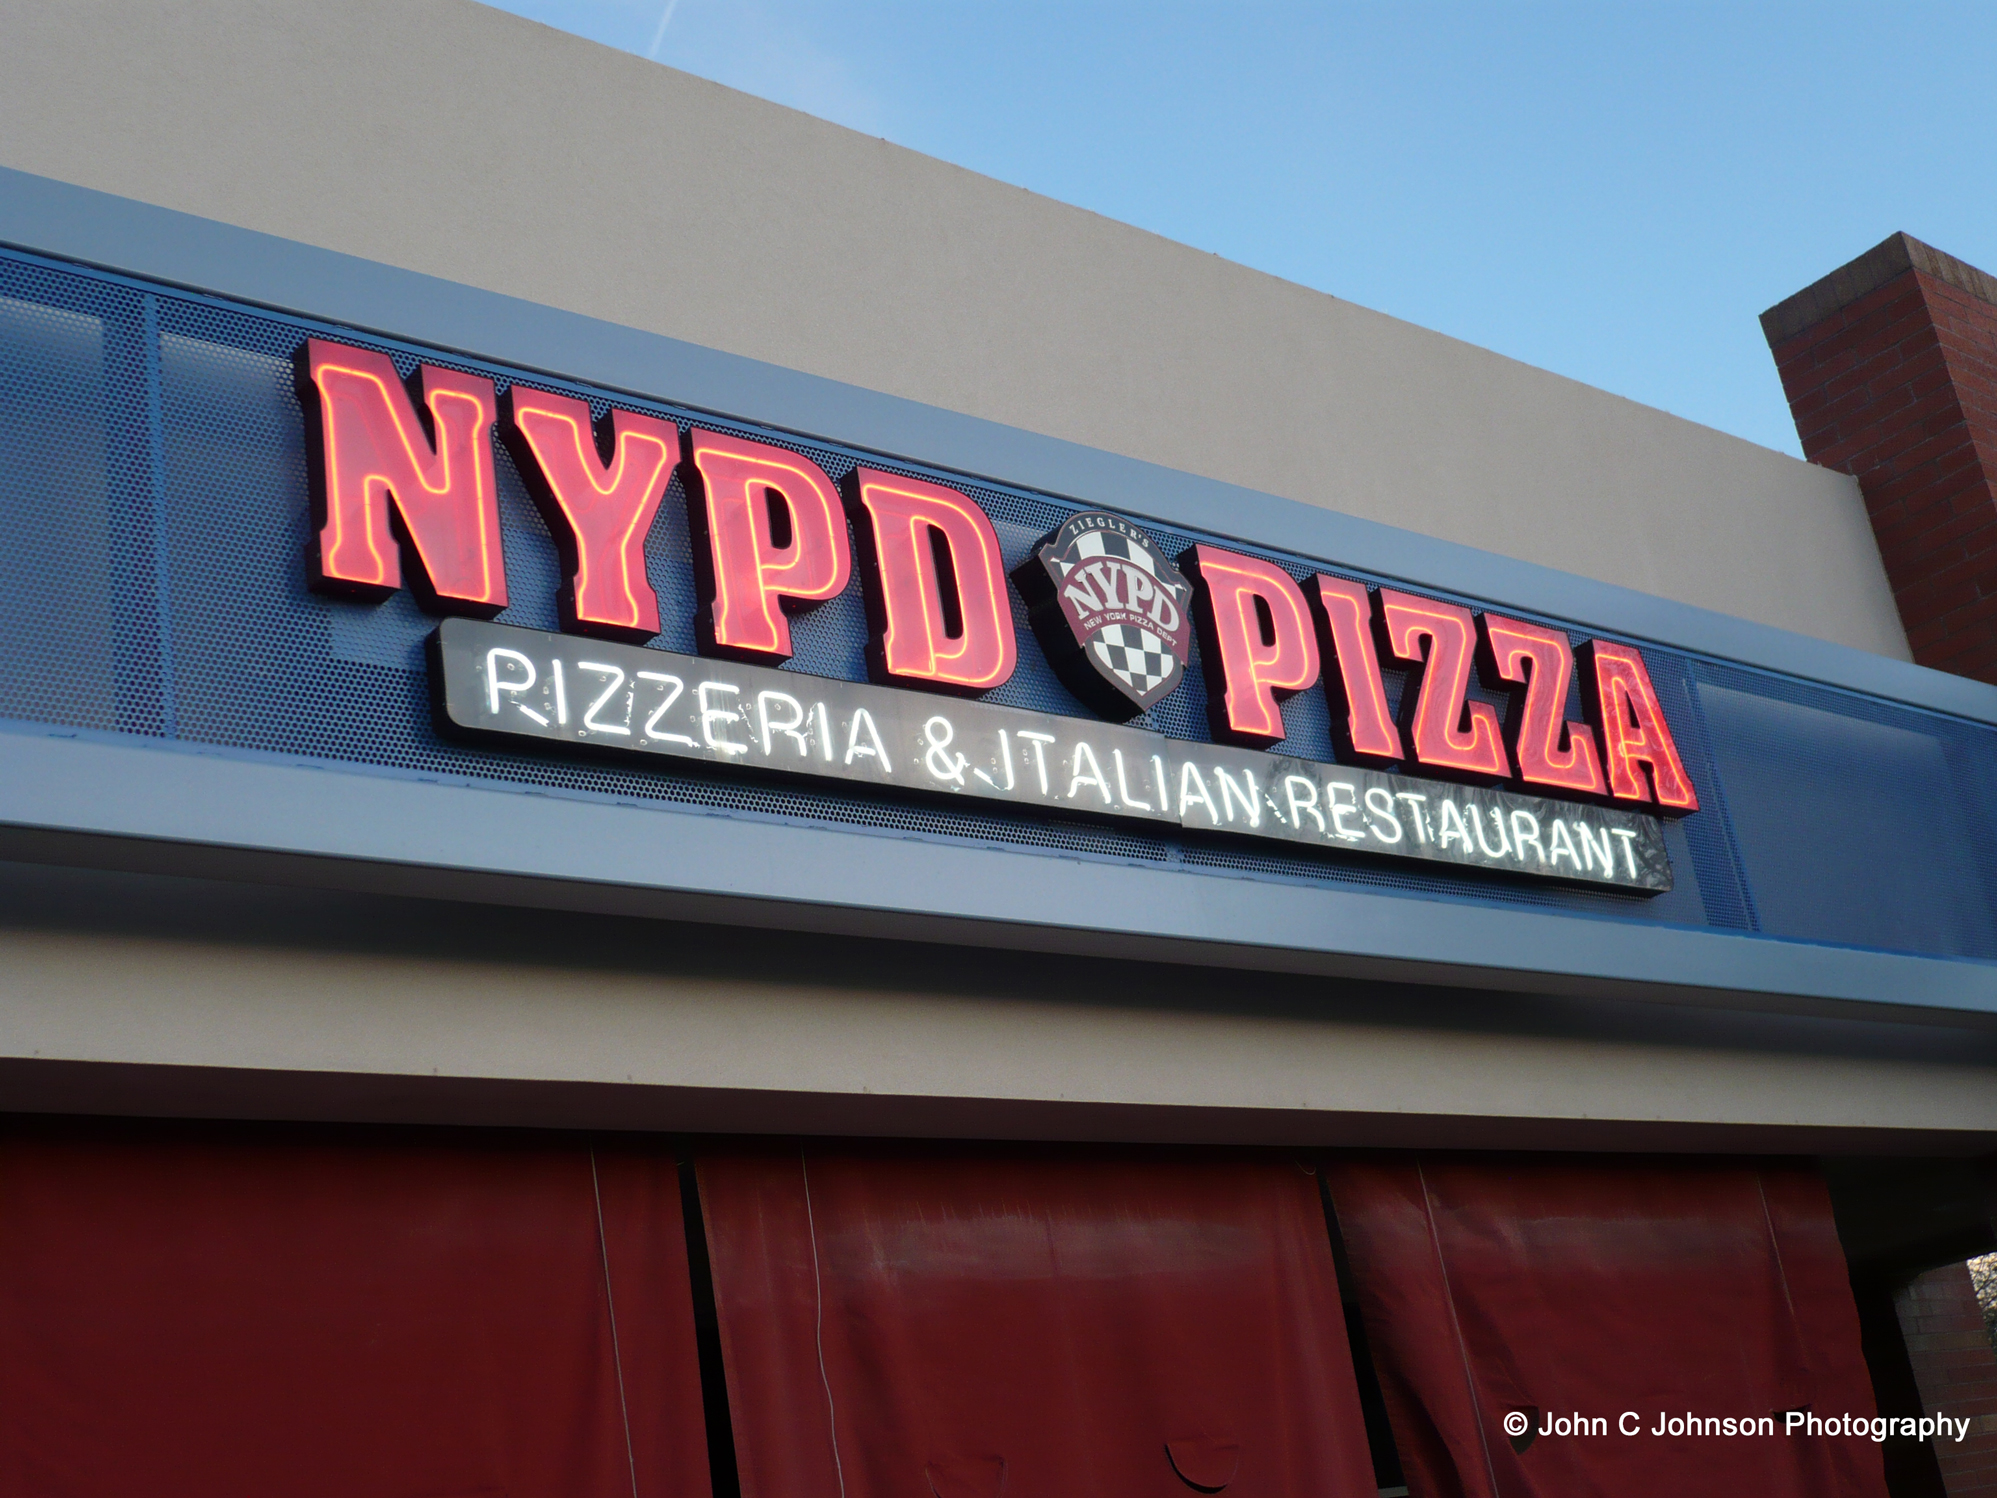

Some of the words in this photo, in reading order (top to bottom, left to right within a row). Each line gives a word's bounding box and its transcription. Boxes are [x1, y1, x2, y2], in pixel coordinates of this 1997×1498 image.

[1068, 517, 1149, 548] ZIEGLER'S
[308, 338, 1018, 697] NYPD
[1195, 543, 1700, 815] PIZZA
[1063, 560, 1180, 632] NYPD
[1083, 615, 1103, 631] NEW
[1104, 612, 1127, 621] YORK
[1129, 614, 1154, 631] PIZZA
[1156, 627, 1178, 647] DEPT
[486, 647, 892, 774] PIZZERIA
[925, 716, 969, 785] &
[996, 729, 1260, 828] ITALIAN
[1284, 775, 1640, 881] RESTAURANT
